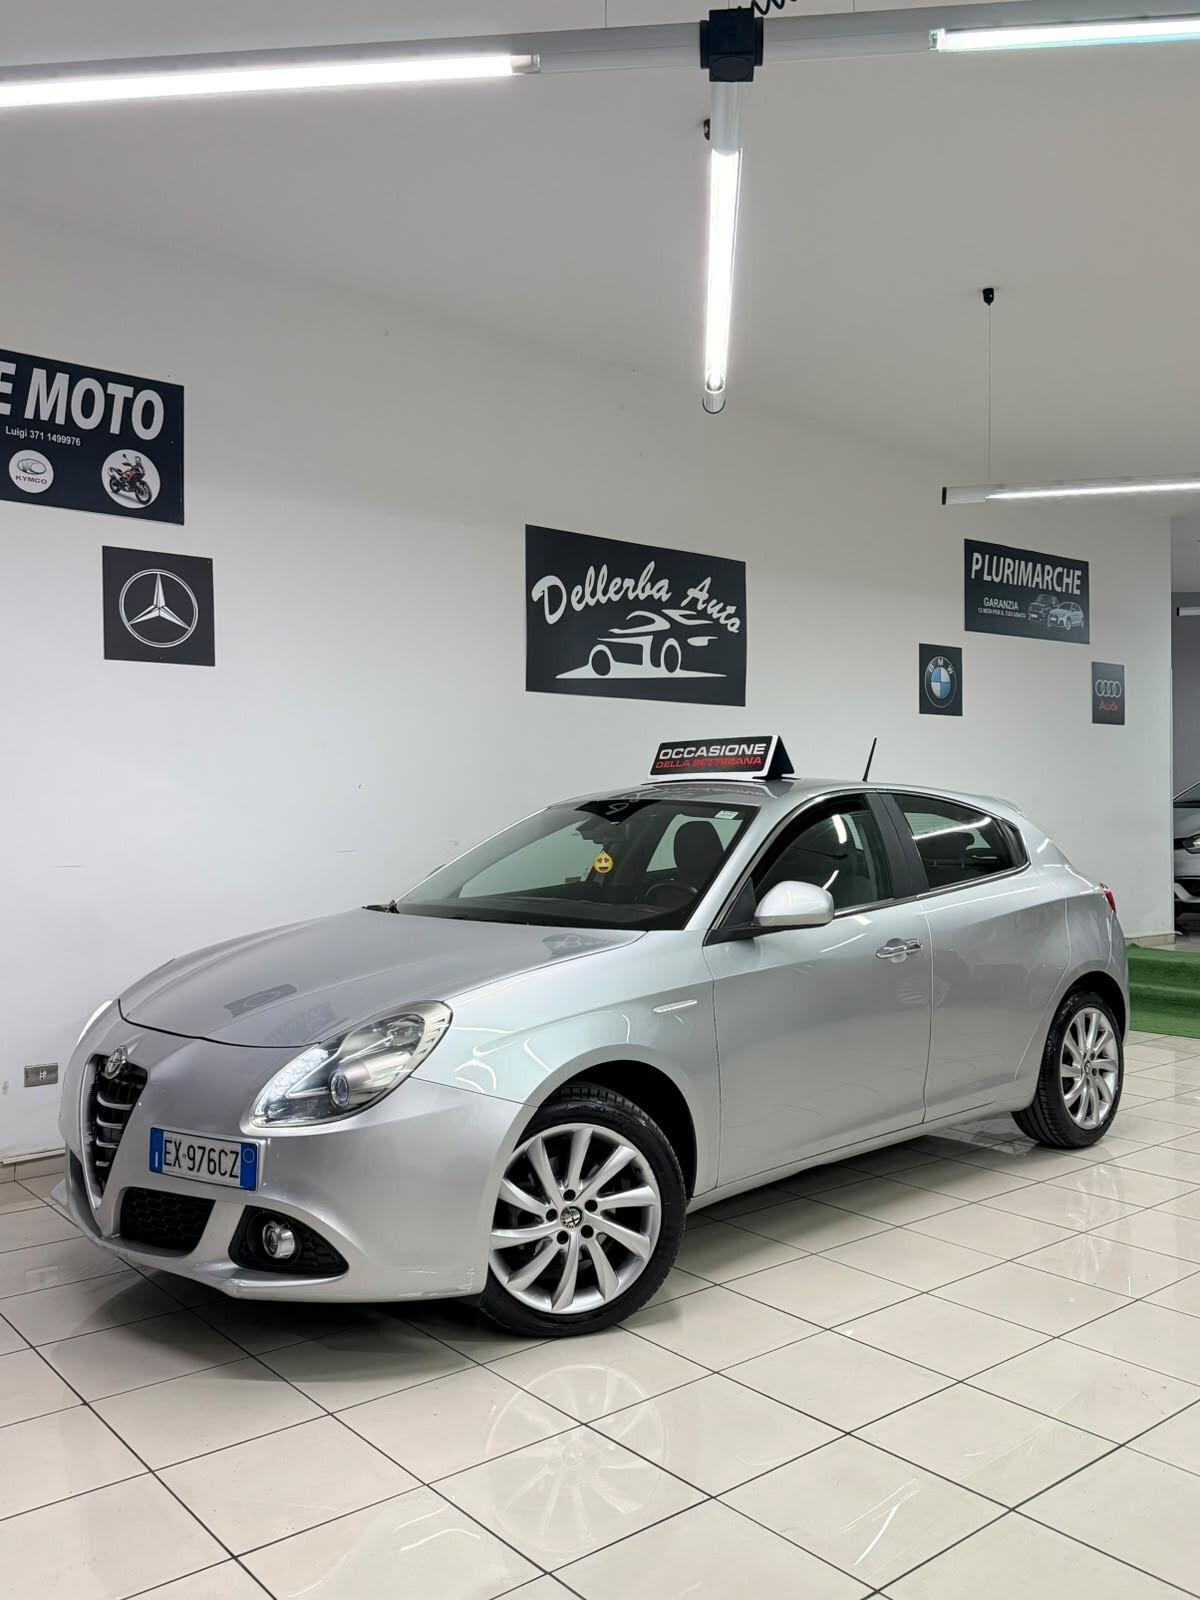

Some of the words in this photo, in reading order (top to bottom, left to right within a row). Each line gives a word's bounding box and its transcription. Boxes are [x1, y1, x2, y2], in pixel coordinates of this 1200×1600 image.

[0, 361, 16, 416] E
[24, 367, 165, 440] MOTO
[5, 425, 28, 439] Luigi
[29, 430, 44, 440] 371
[47, 433, 81, 446] 1499976
[15, 475, 48, 485] KYMCO
[971, 552, 1082, 595] PLURIMARCHE
[531, 560, 672, 625] Dellerba
[680, 576, 741, 633] Auto
[983, 597, 1019, 610] GARANZIA
[928, 657, 954, 674] BMW
[1099, 700, 1119, 711] Audi
[660, 743, 766, 760] OCCASIONE
[655, 759, 691, 769] DELLA
